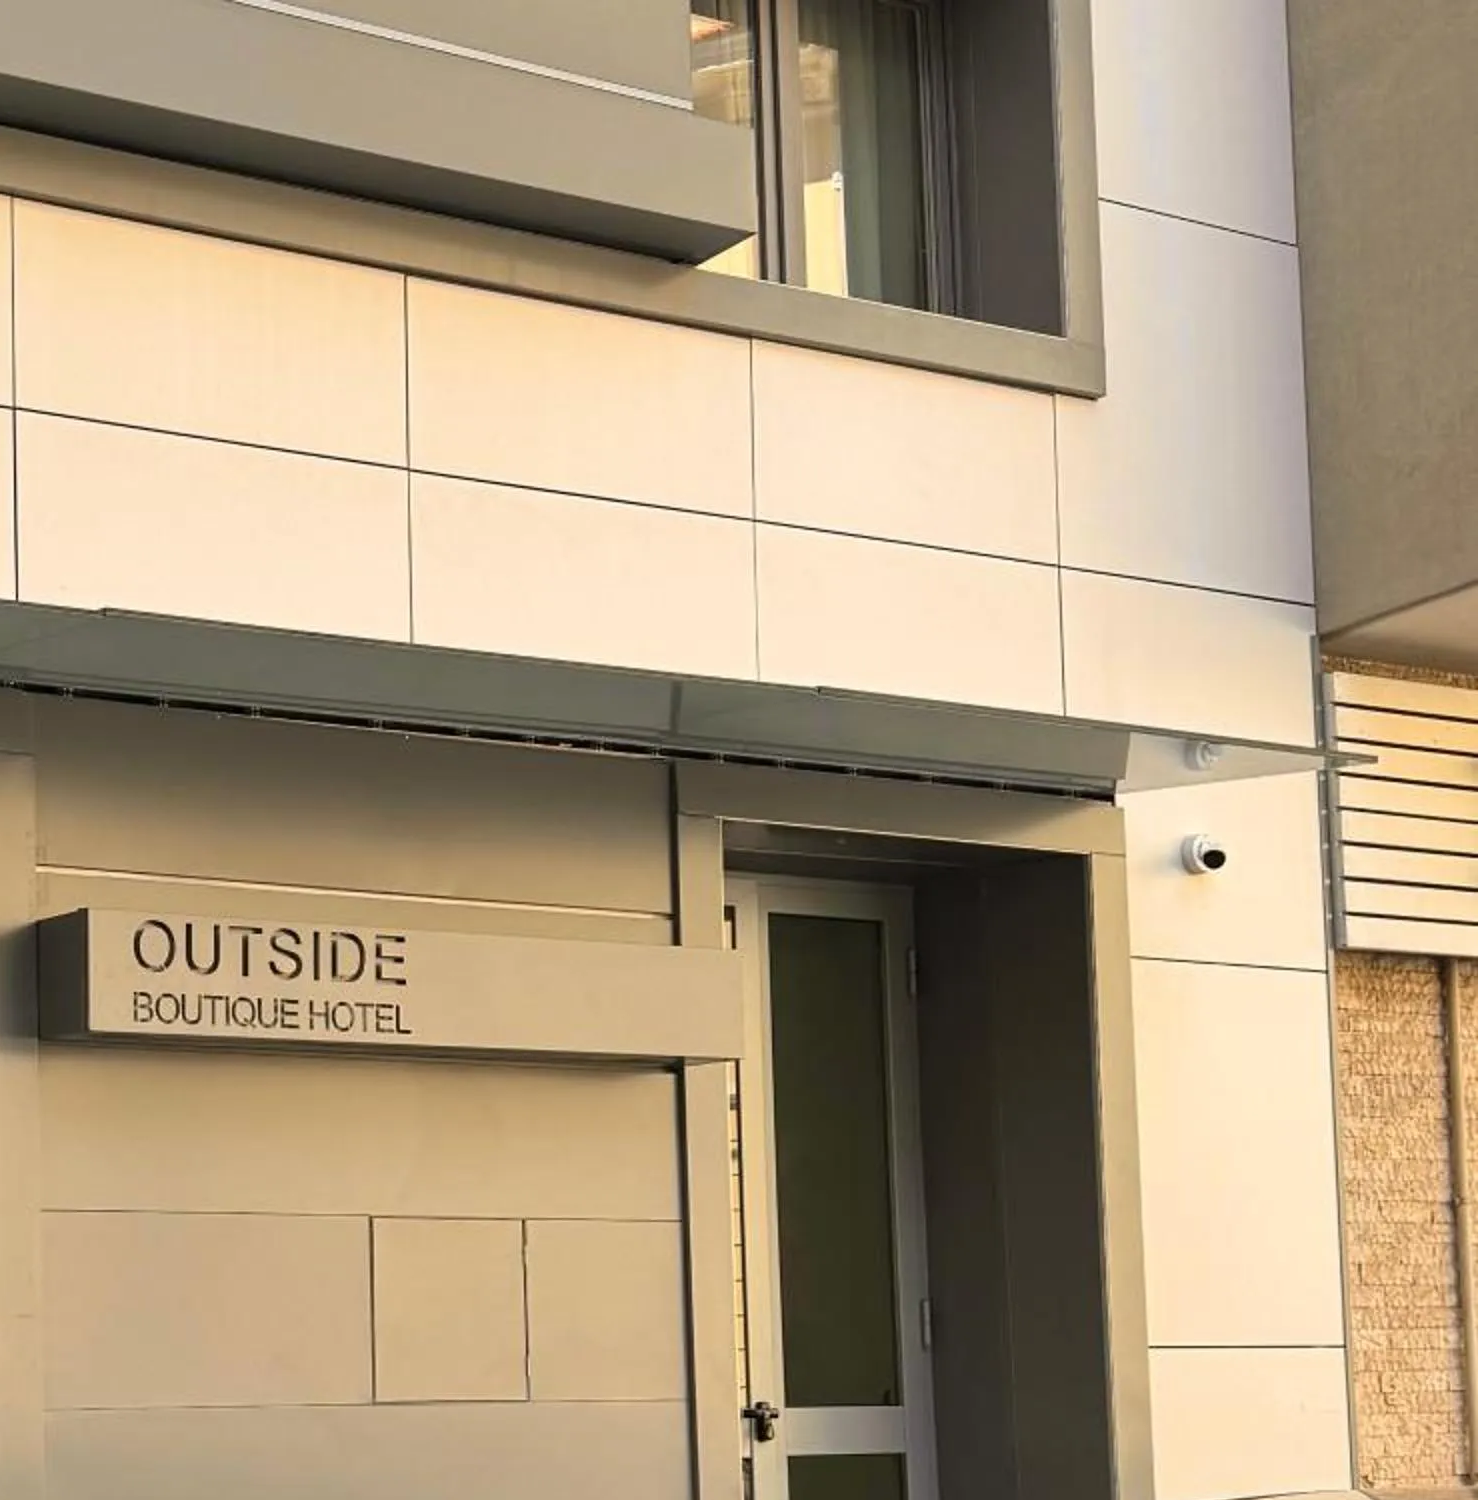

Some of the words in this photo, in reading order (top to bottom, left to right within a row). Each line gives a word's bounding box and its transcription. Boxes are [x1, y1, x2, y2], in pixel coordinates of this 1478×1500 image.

[132, 918, 408, 987] OUTSIDE
[132, 991, 301, 1031] BOUTIQUE
[308, 1000, 413, 1035] HOTEL
